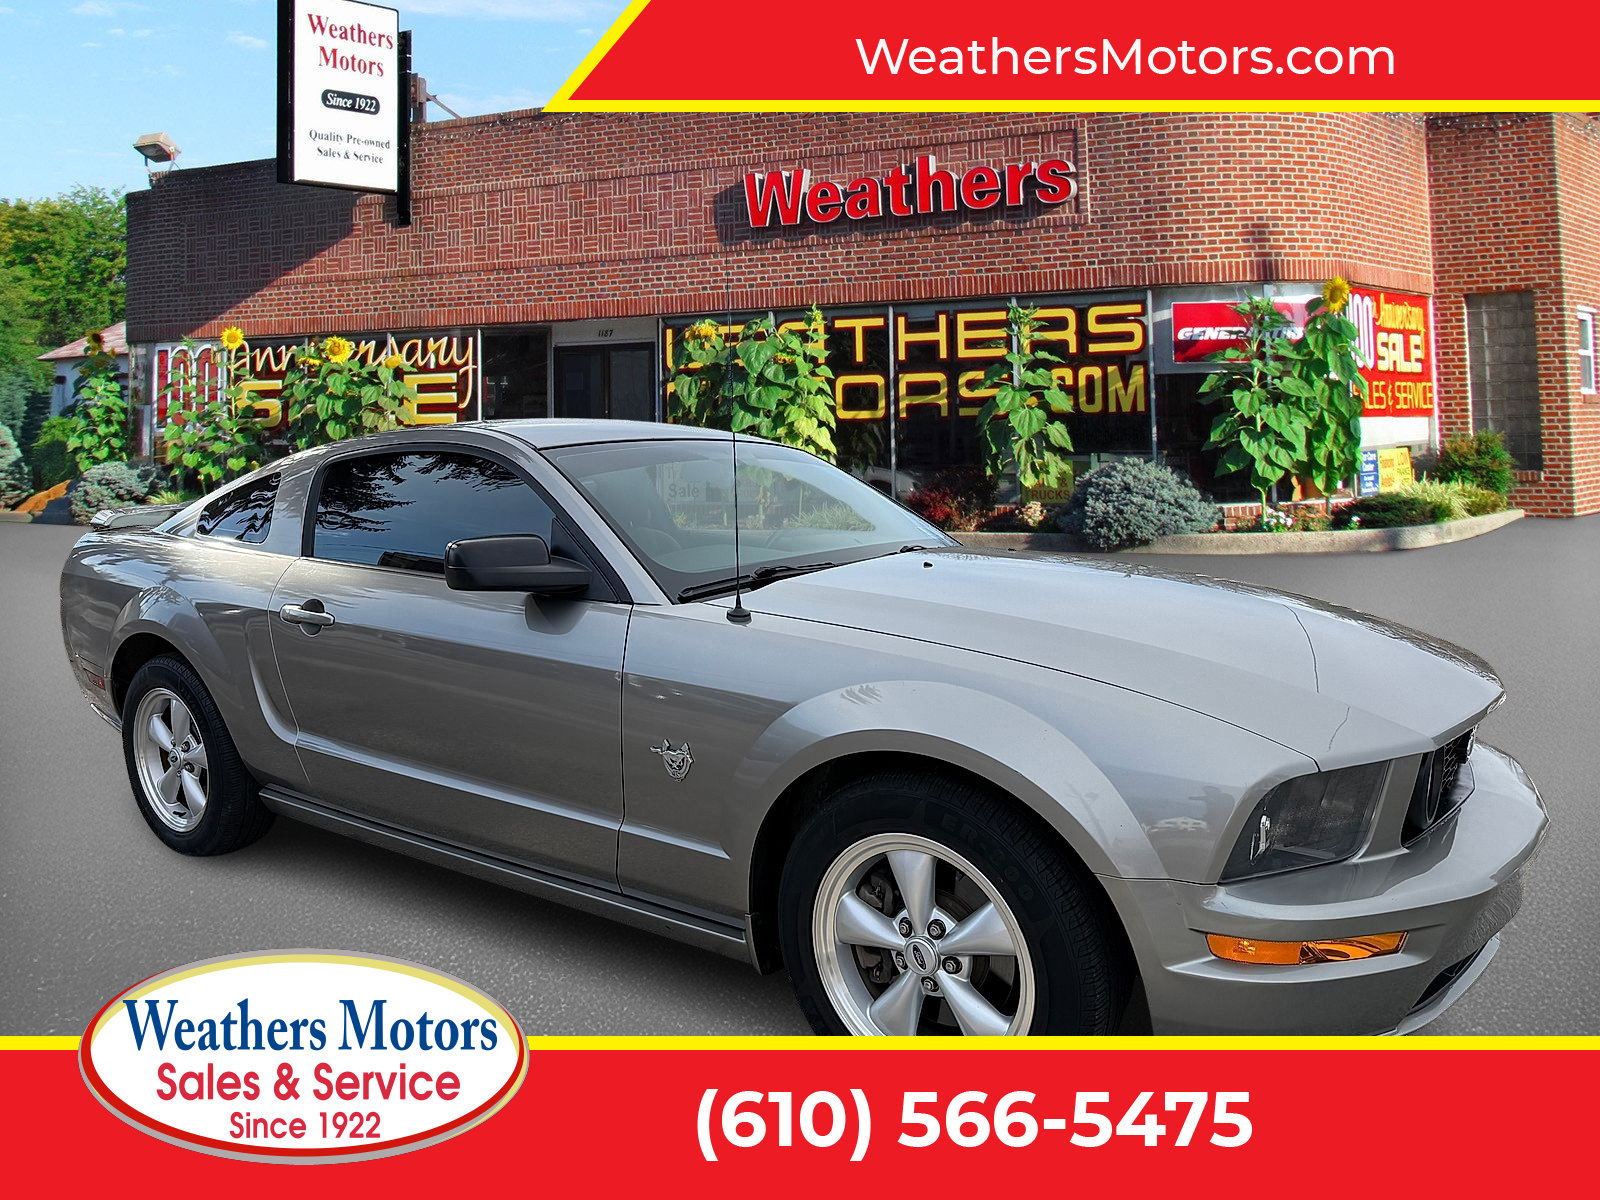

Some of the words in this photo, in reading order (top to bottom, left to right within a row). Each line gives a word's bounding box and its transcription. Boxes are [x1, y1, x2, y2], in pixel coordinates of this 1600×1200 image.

[307, 13, 394, 50] Weathers
[318, 45, 384, 77] Motors
[326, 92, 353, 109] Since
[355, 97, 377, 112] 1922
[309, 129, 343, 145] Quality
[346, 133, 391, 149] Pre-owned
[316, 145, 341, 158] Sales
[343, 150, 351, 160] &
[353, 151, 384, 164] Service
[744, 155, 1077, 228] Weathers
[598, 328, 614, 338] 1187
[1376, 332, 1423, 373] SALE
[235, 372, 458, 428] SE
[1353, 381, 1387, 410] LES
[1394, 381, 1434, 409] SERVICE
[668, 483, 700, 498] Sale
